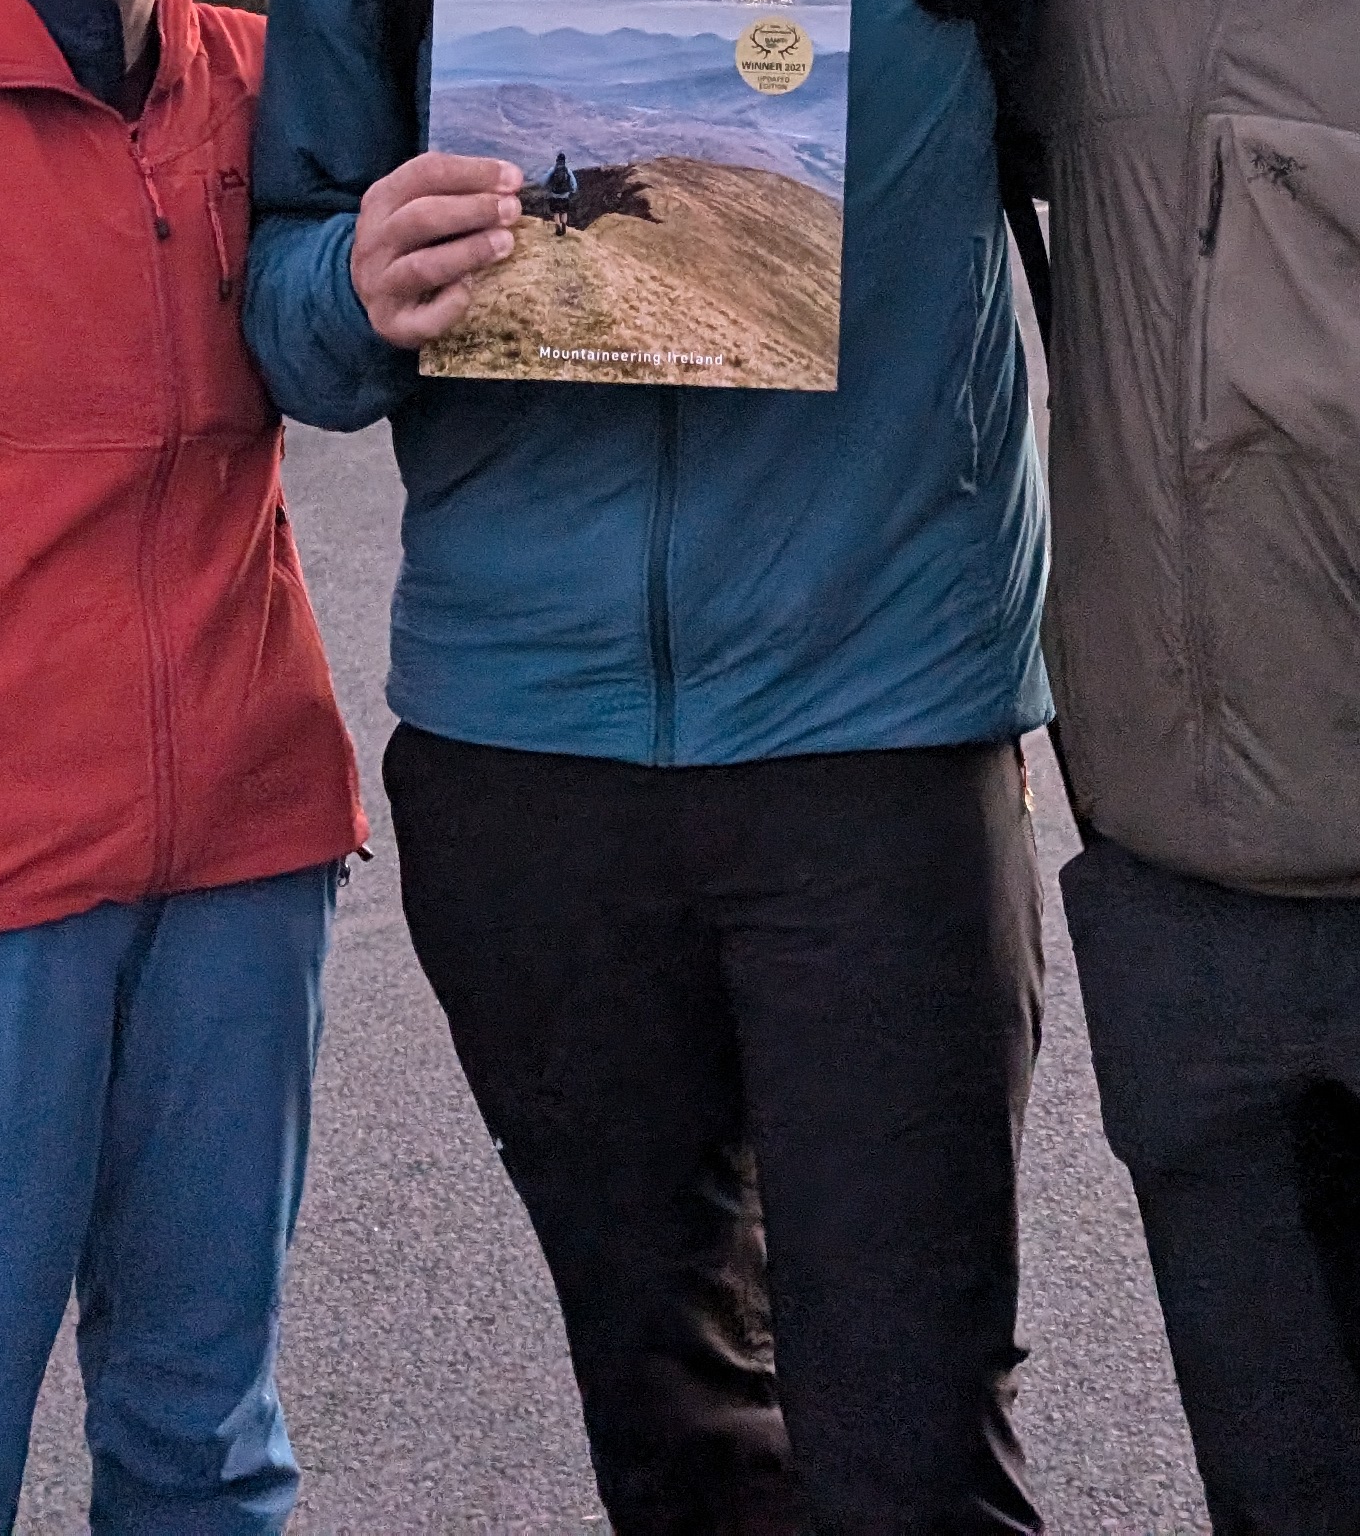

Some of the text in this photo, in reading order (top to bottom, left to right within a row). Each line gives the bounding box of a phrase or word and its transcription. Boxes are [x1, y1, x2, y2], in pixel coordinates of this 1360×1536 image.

[741, 61, 806, 72] WINNER 2021
[757, 75, 790, 83] UPDATD
[539, 346, 723, 366] Mountaineering Ireland
